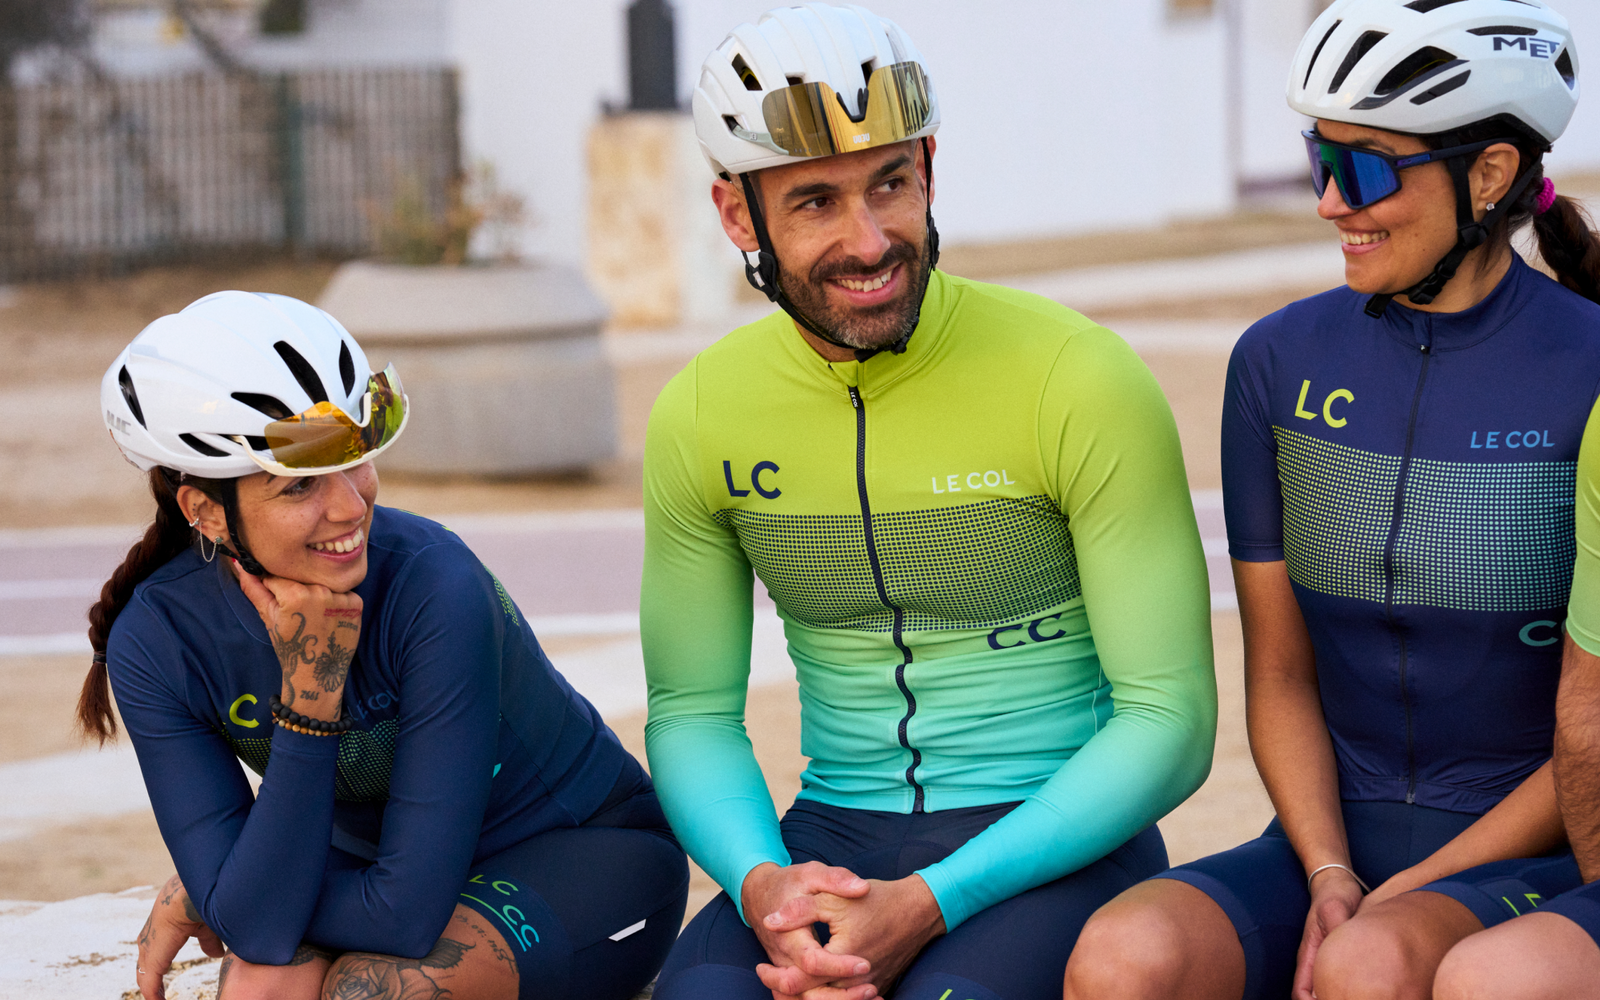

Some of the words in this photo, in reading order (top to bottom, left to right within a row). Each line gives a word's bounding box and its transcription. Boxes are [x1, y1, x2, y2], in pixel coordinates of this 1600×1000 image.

[1493, 37, 1560, 59] MET
[1294, 379, 1355, 429] LC
[1470, 431, 1501, 449] LE
[1505, 430, 1555, 449] COL
[722, 460, 782, 500] LC
[931, 474, 961, 495] LE
[966, 469, 1016, 490] COL
[987, 613, 1067, 650] CC
[1518, 620, 1567, 647] C
[223, 693, 260, 729] C
[468, 874, 519, 896] LC
[502, 904, 540, 948] CC
